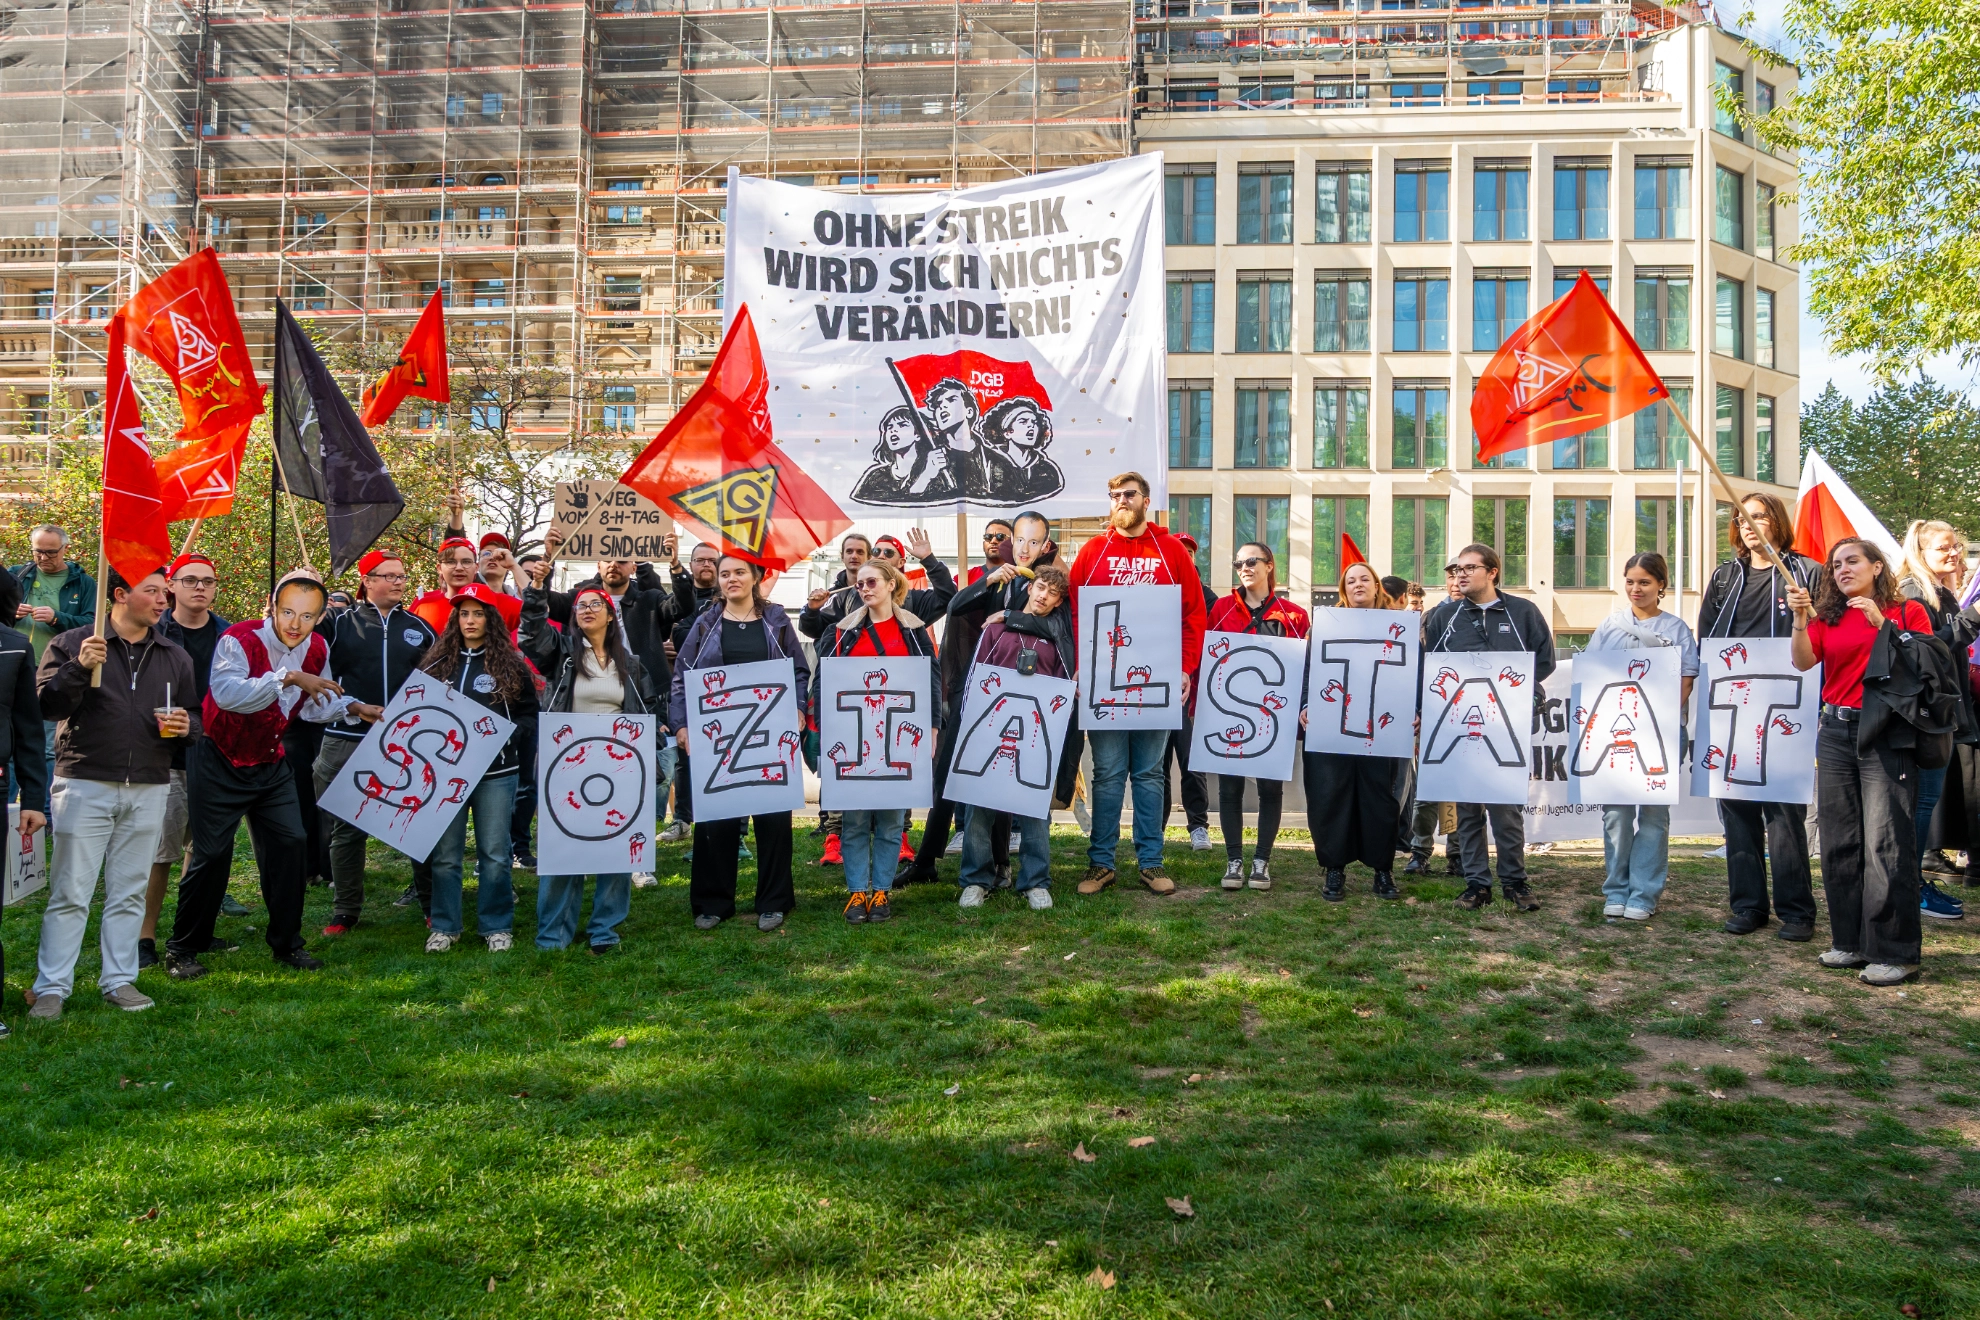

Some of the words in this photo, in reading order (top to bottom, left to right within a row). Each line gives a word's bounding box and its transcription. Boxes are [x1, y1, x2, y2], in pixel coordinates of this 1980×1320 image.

[764, 247, 878, 294] WIRD
[888, 254, 978, 294] SICH
[990, 238, 1122, 290] NICHTS
[814, 210, 927, 248] OHNE
[936, 196, 1068, 245] STREIK
[815, 294, 1070, 342] VERÄNDERN!
[970, 370, 1004, 387] DGB
[558, 510, 588, 524] VOM
[599, 510, 660, 525] 8-H-TAG
[595, 491, 636, 506] WEG
[1107, 556, 1162, 572] TARIF
[1108, 569, 1158, 586] Fighter
[1090, 600, 1170, 709] L
[1322, 639, 1406, 738] T
[698, 683, 788, 794] Z
[836, 690, 916, 781] I
[952, 692, 1052, 790] A
[1204, 646, 1285, 758] S
[1423, 678, 1526, 767] A
[1571, 681, 1668, 776] A
[1710, 674, 1802, 786] T
[354, 704, 468, 810] S
[544, 736, 646, 842] O
